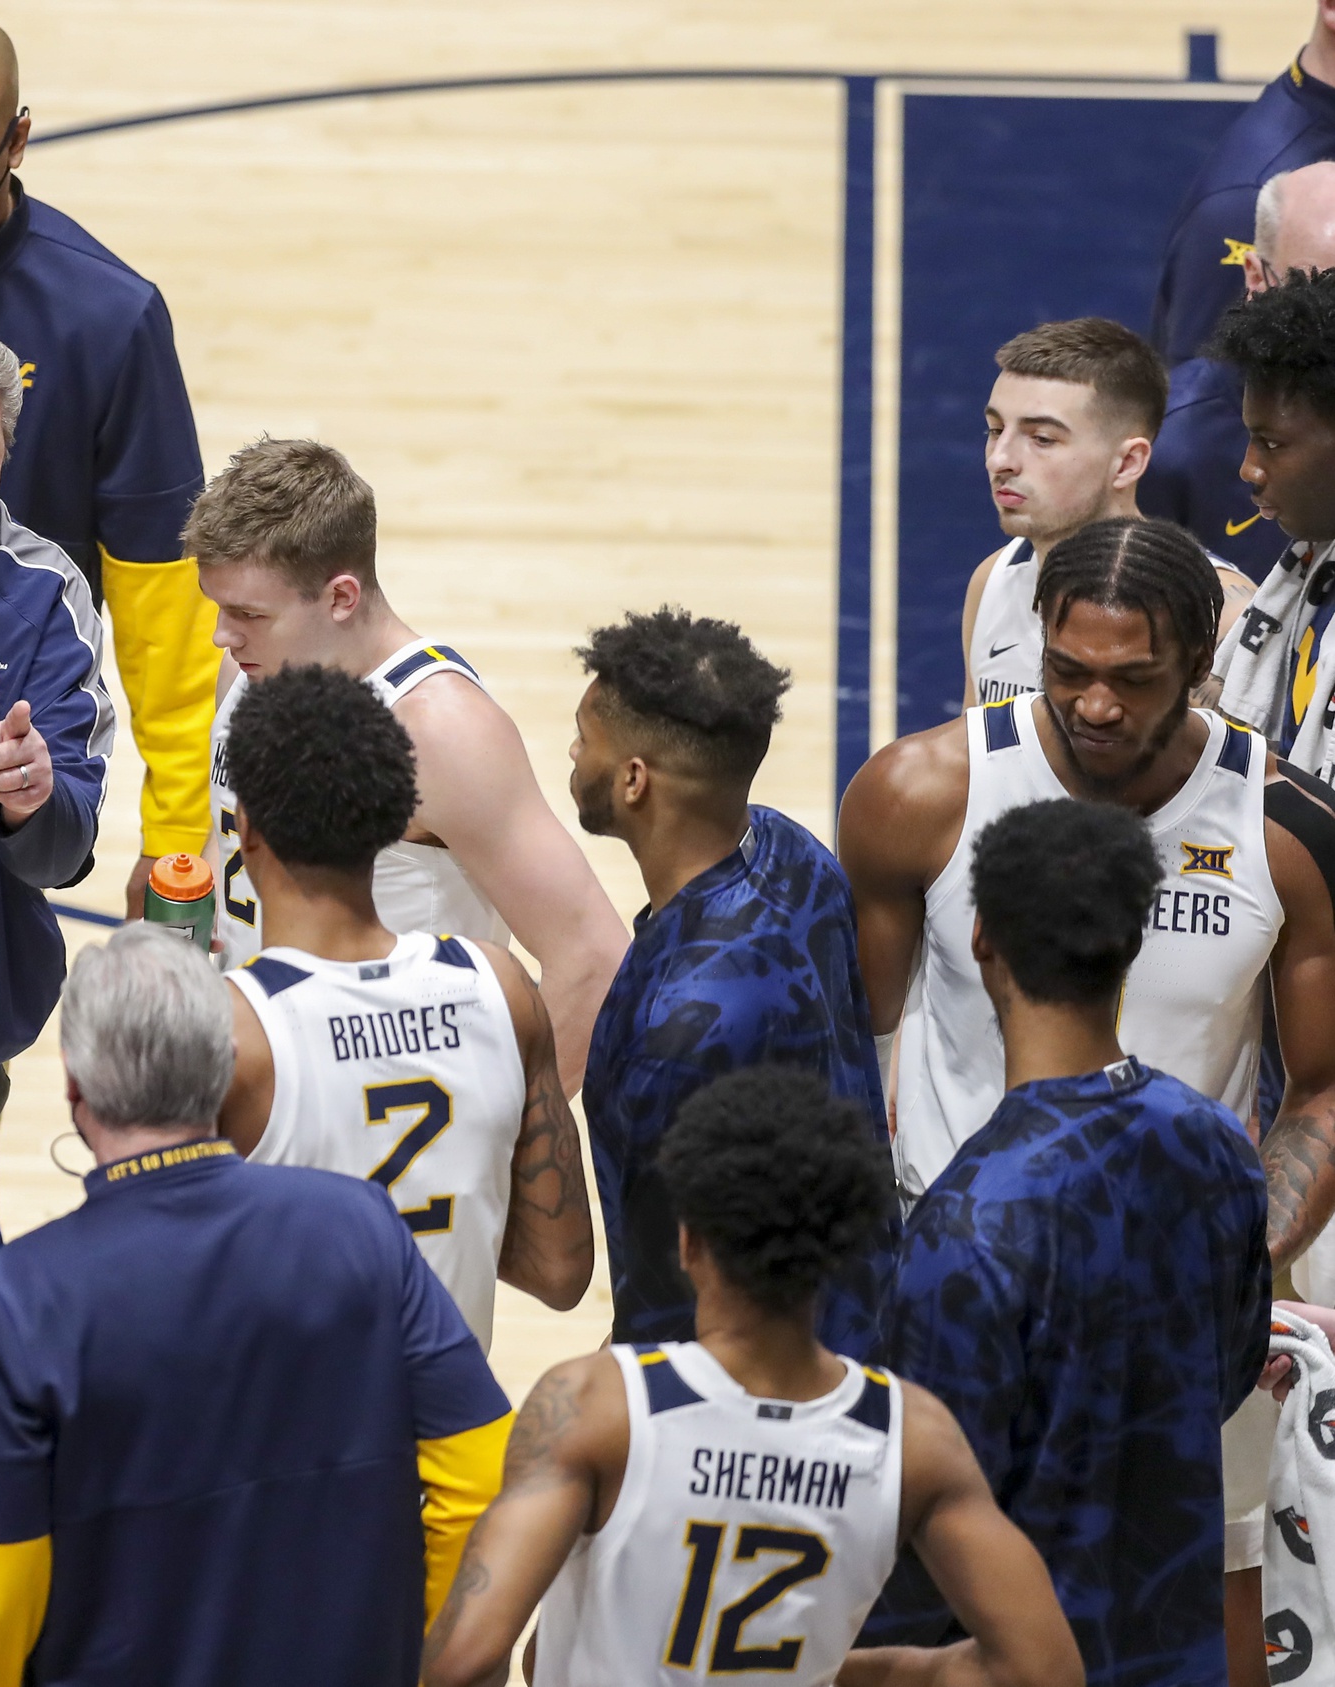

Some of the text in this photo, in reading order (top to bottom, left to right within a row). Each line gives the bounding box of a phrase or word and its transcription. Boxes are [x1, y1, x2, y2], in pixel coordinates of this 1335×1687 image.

[979, 677, 1036, 705] MOU
[1153, 889, 1230, 936] EERS
[329, 1003, 461, 1062] BRIDGES
[362, 1075, 456, 1237] 2
[689, 1447, 853, 1509] SHERMAN
[661, 1516, 835, 1677] 12
